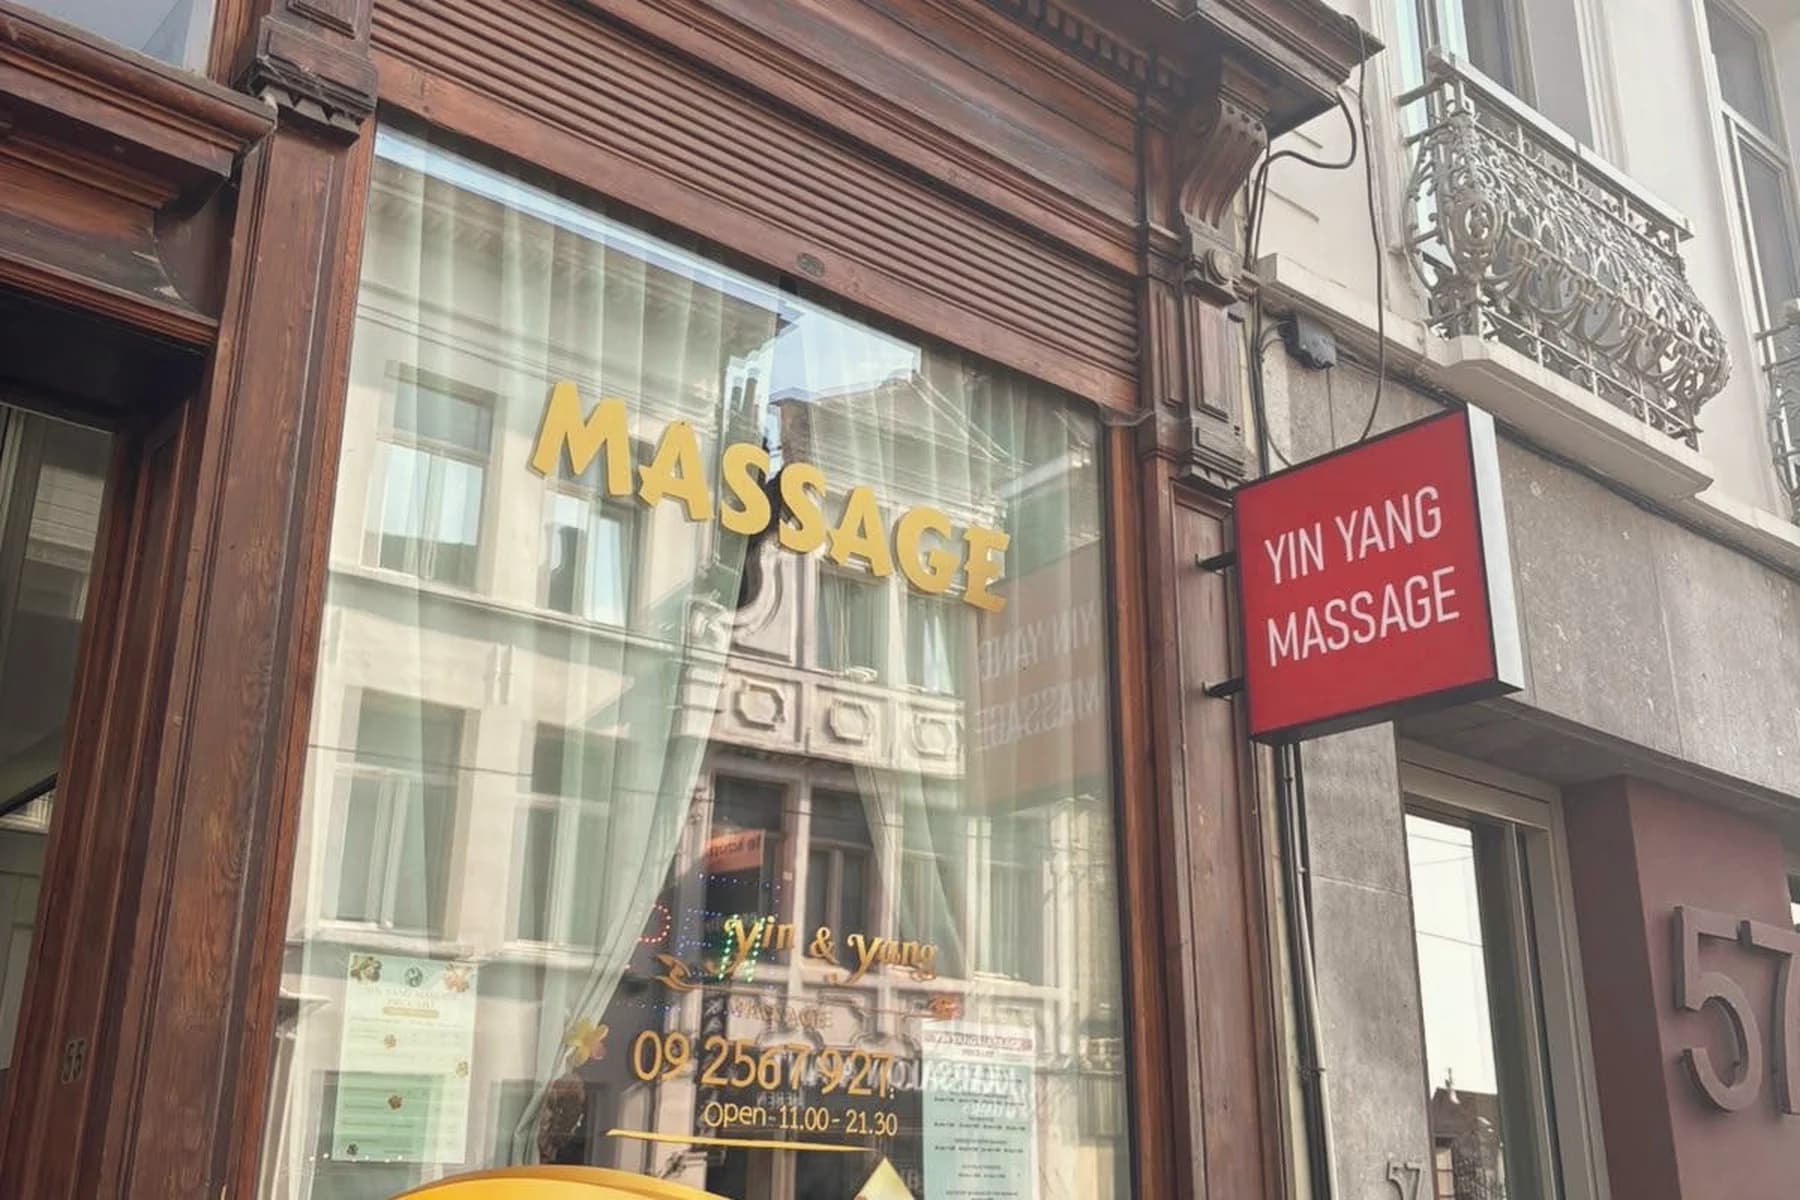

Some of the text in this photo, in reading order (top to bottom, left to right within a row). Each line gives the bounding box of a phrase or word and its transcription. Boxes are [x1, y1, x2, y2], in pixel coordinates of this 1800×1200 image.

[526, 380, 1010, 613] MASSAGE
[1264, 486, 1442, 585] YIN YANG
[1267, 565, 1460, 667] MASSAGE
[808, 926, 838, 964] &
[634, 1029, 691, 1081] 09
[701, 1036, 813, 1090] 2567
[1674, 905, 1800, 1115] 57
[704, 1101, 767, 1128] Open
[779, 1106, 829, 1131] 11.00
[845, 1108, 898, 1137] 21.30
